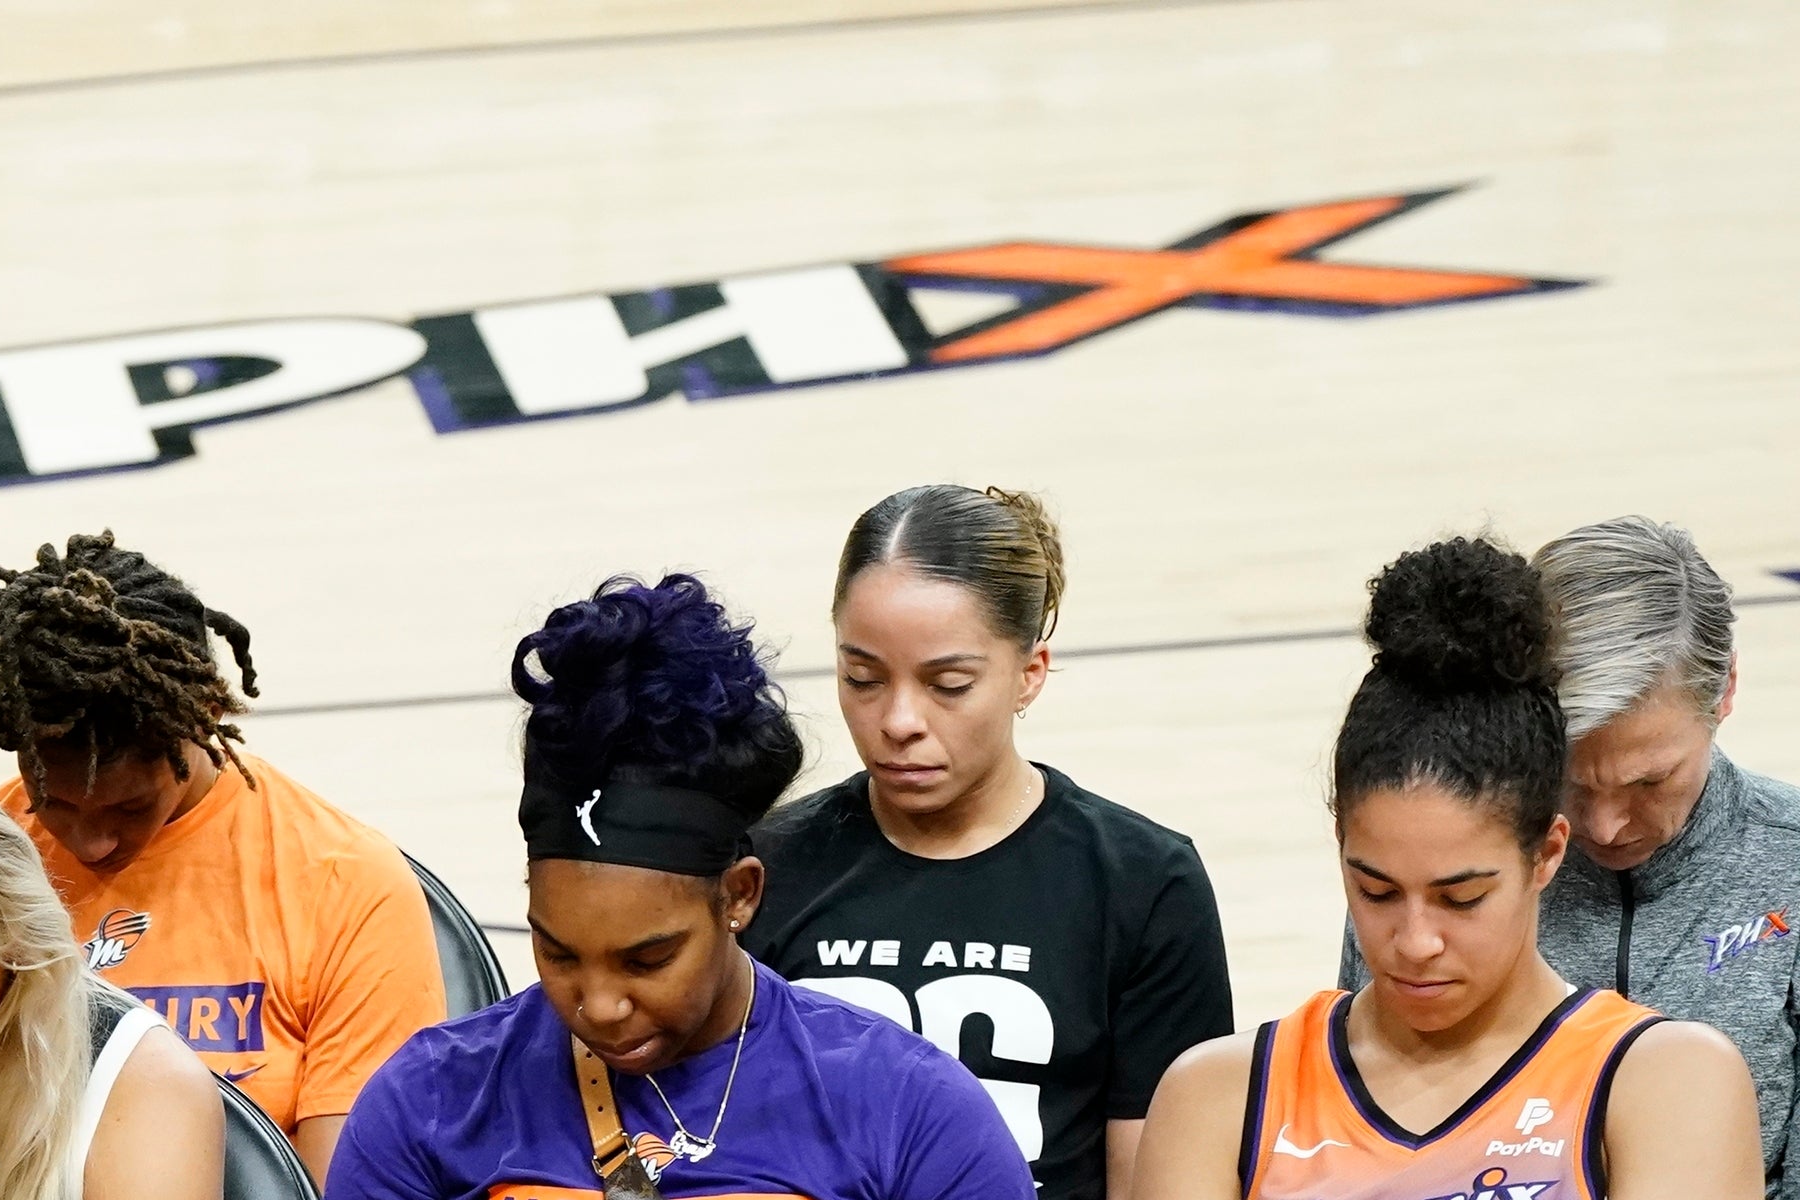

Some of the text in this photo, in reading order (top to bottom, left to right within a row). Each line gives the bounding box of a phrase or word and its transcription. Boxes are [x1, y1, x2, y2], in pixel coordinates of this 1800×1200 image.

[1702, 905, 1790, 973] PHX
[817, 940, 1031, 972] WE ARE
[1485, 1136, 1565, 1157] PayPal
